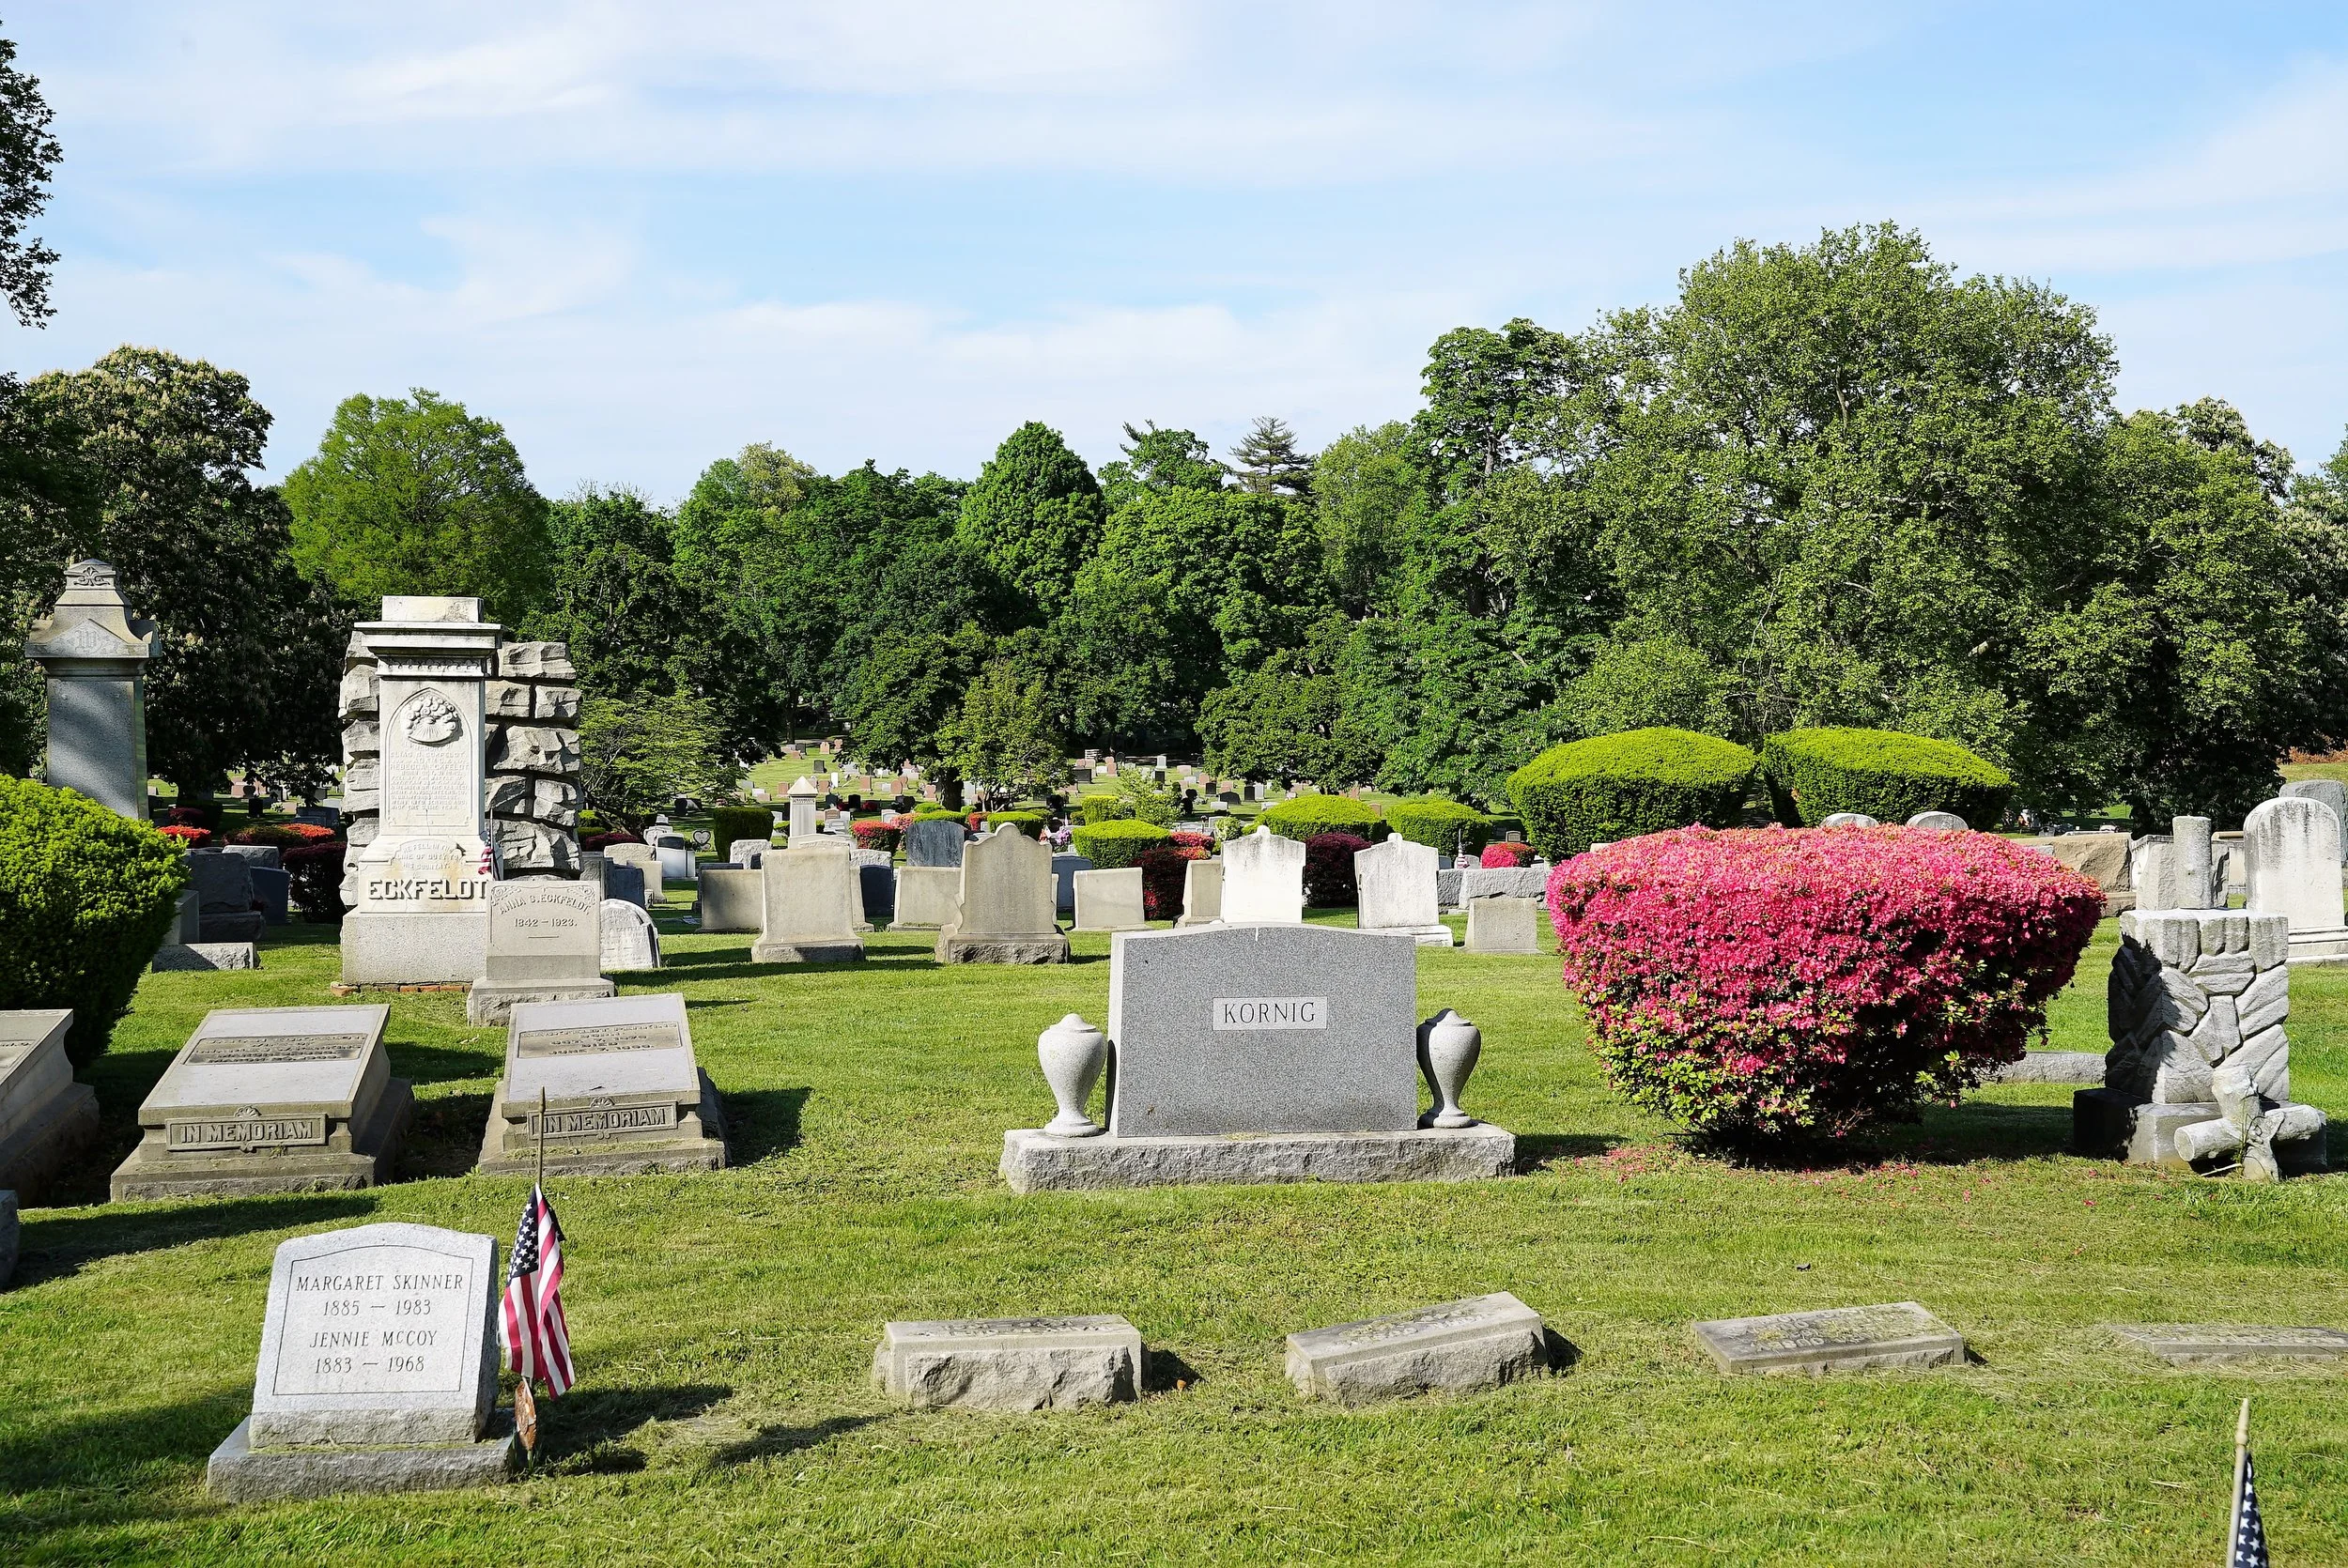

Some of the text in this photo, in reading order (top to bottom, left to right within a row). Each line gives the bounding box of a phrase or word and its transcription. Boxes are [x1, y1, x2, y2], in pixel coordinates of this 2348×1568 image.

[368, 879, 488, 899] ECKFELDT
[499, 897, 527, 915] ANNA
[514, 918, 538, 928] 1842
[1223, 1002, 1315, 1023] KORNIG
[544, 1108, 666, 1133] IN MEMORIAM
[180, 1120, 313, 1144] IN MEMORIAM
[296, 1274, 464, 1292] MARGARET SKINNER
[323, 1299, 361, 1316] 1885
[395, 1299, 432, 1315] 1983
[310, 1331, 370, 1348] JENNIE
[315, 1357, 352, 1374] 1883
[388, 1356, 425, 1373] 1968
